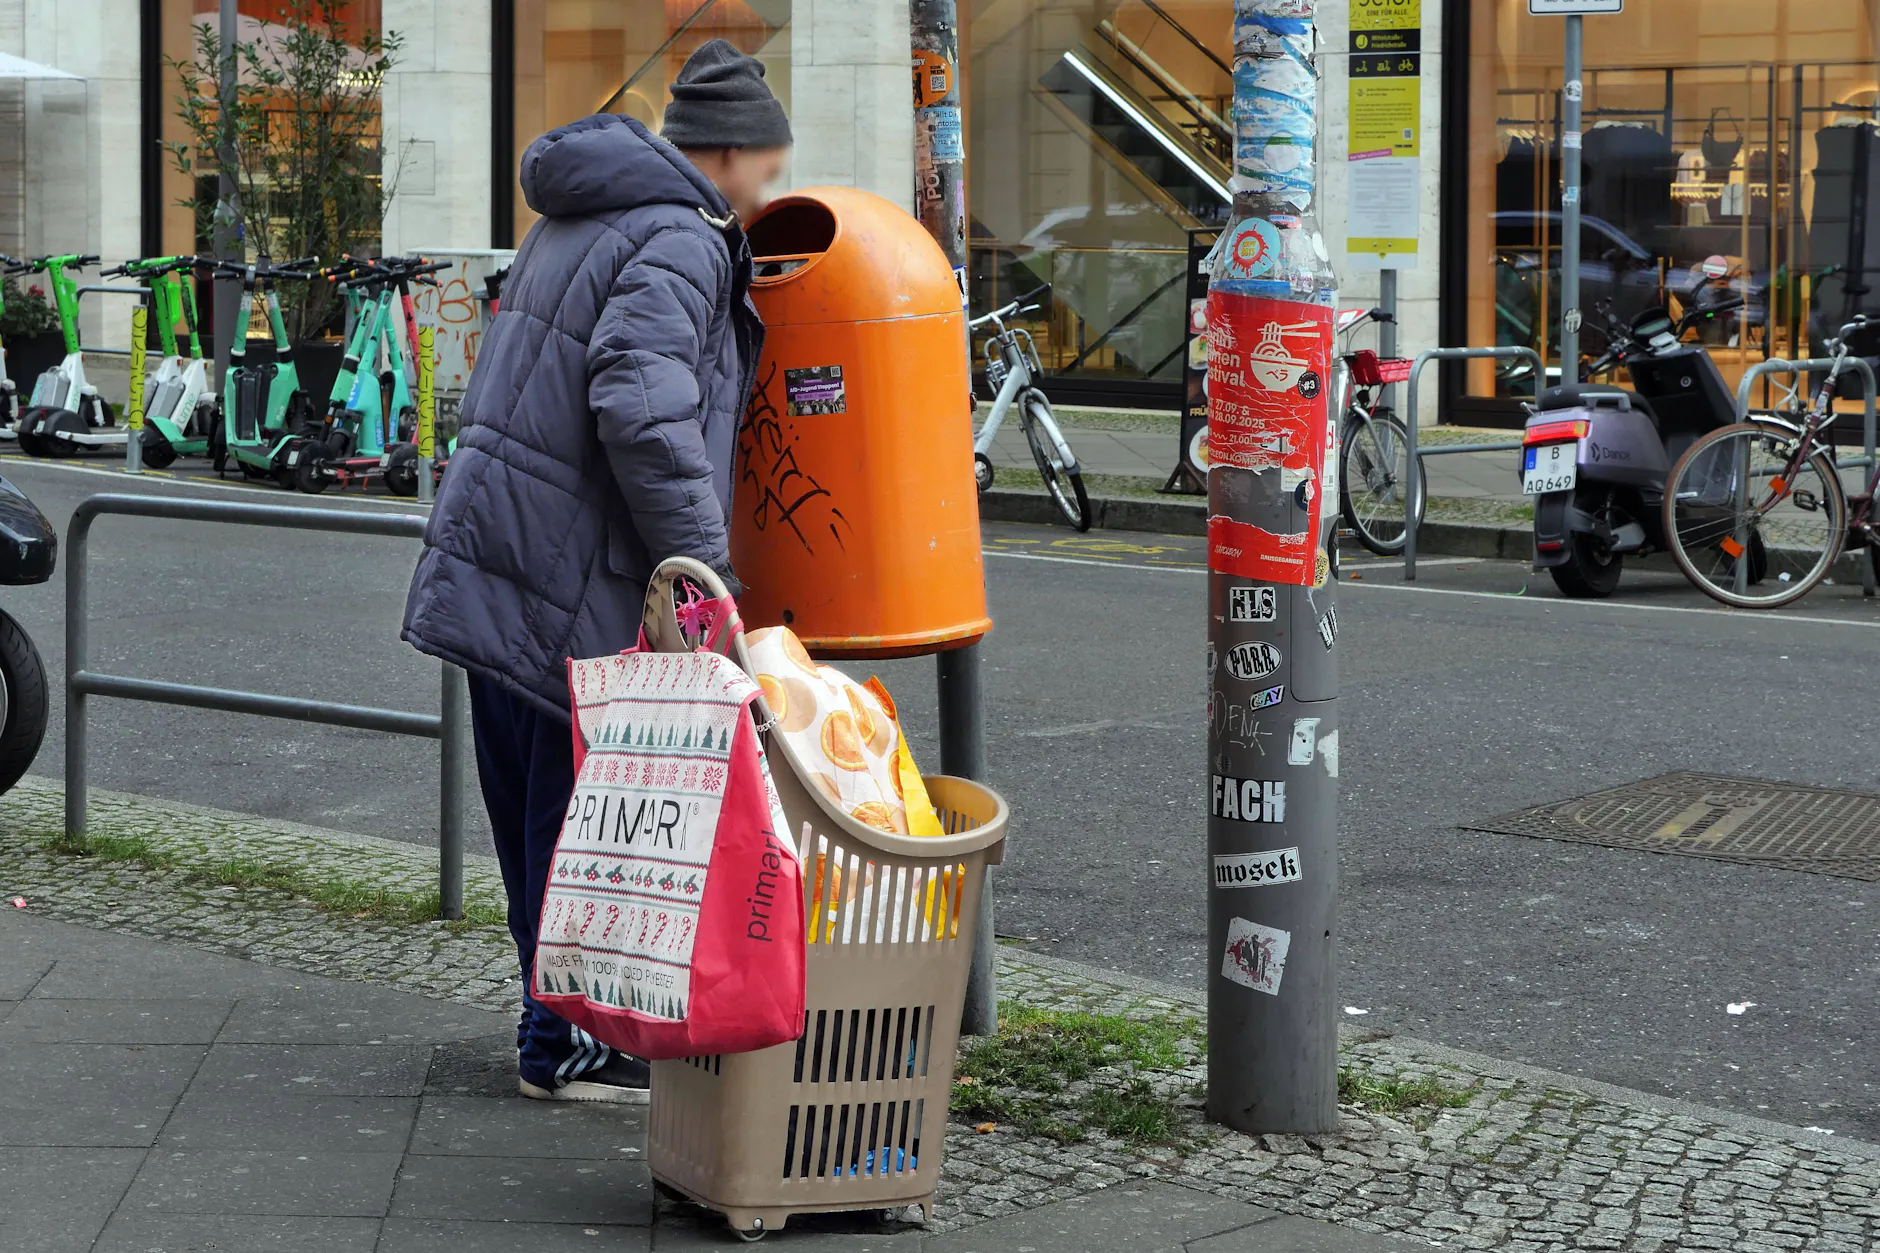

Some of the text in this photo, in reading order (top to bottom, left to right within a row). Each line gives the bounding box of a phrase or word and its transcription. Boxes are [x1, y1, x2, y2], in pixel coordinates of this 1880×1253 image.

[1367, 9, 1379, 17] EINE
[1381, 8, 1392, 16] FÜR
[1266, 369, 1288, 382] ベラ
[1215, 398, 1240, 414] 27.09.
[1242, 405, 1250, 416] &
[1215, 410, 1266, 429] 28.09.2025
[1551, 446, 1560, 460] B
[1602, 448, 1631, 460] Dance
[1526, 475, 1572, 493] AQ 649
[1212, 774, 1285, 823] FACH
[545, 953, 571, 968] MADE
